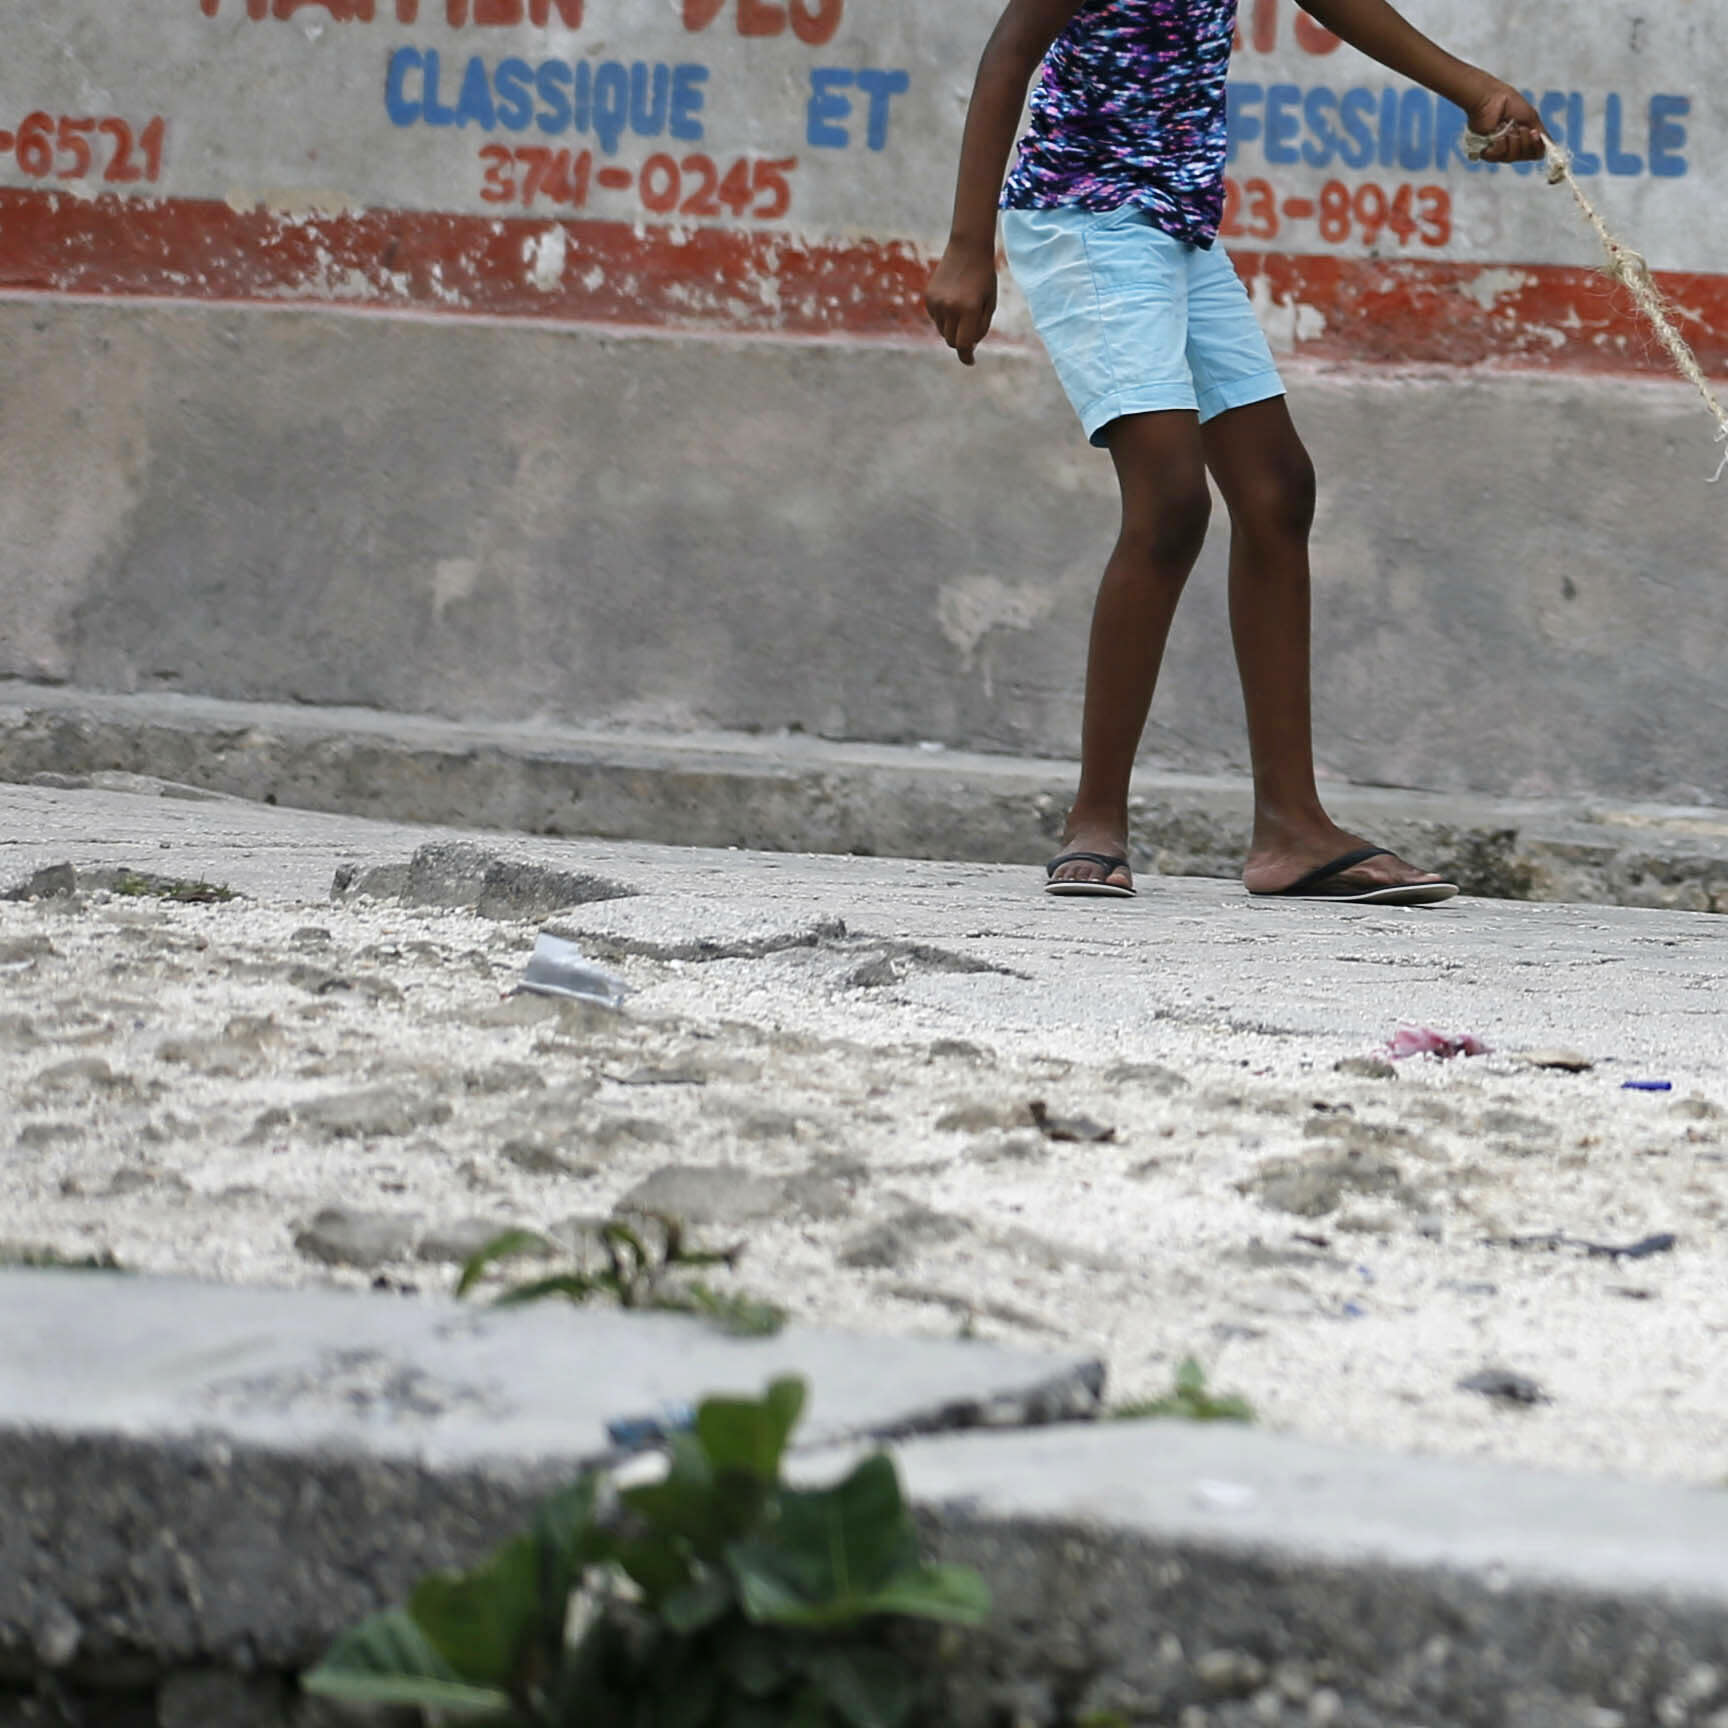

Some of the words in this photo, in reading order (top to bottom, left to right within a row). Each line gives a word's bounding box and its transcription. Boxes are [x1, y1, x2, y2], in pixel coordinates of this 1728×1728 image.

[385, 47, 710, 153] CLASSIQUE
[806, 67, 910, 151] ET
[477, 144, 798, 219] 3741-0245
[1218, 177, 1452, 248] 23-8943
